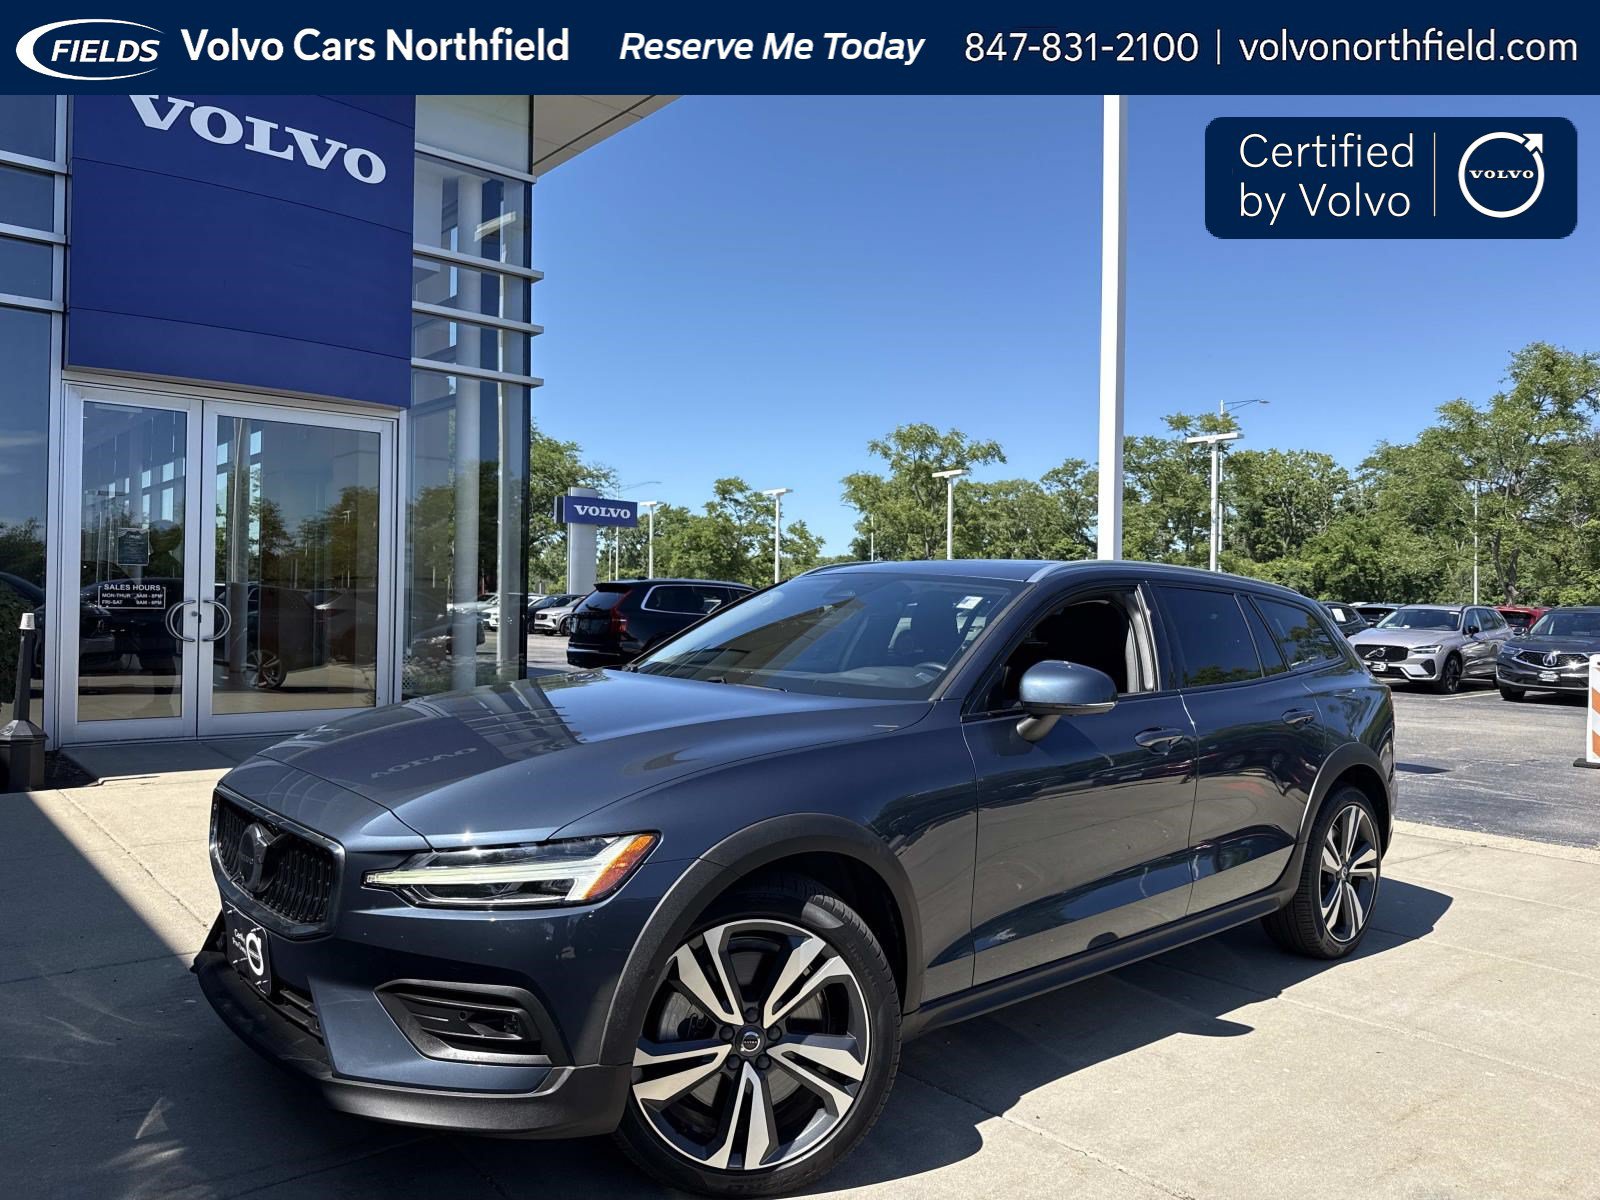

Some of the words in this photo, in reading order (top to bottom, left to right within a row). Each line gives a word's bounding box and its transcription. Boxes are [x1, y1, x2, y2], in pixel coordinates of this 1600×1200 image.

[129, 95, 386, 184] VOLVO
[573, 504, 631, 519] VOLVO
[104, 583, 131, 591] SALES
